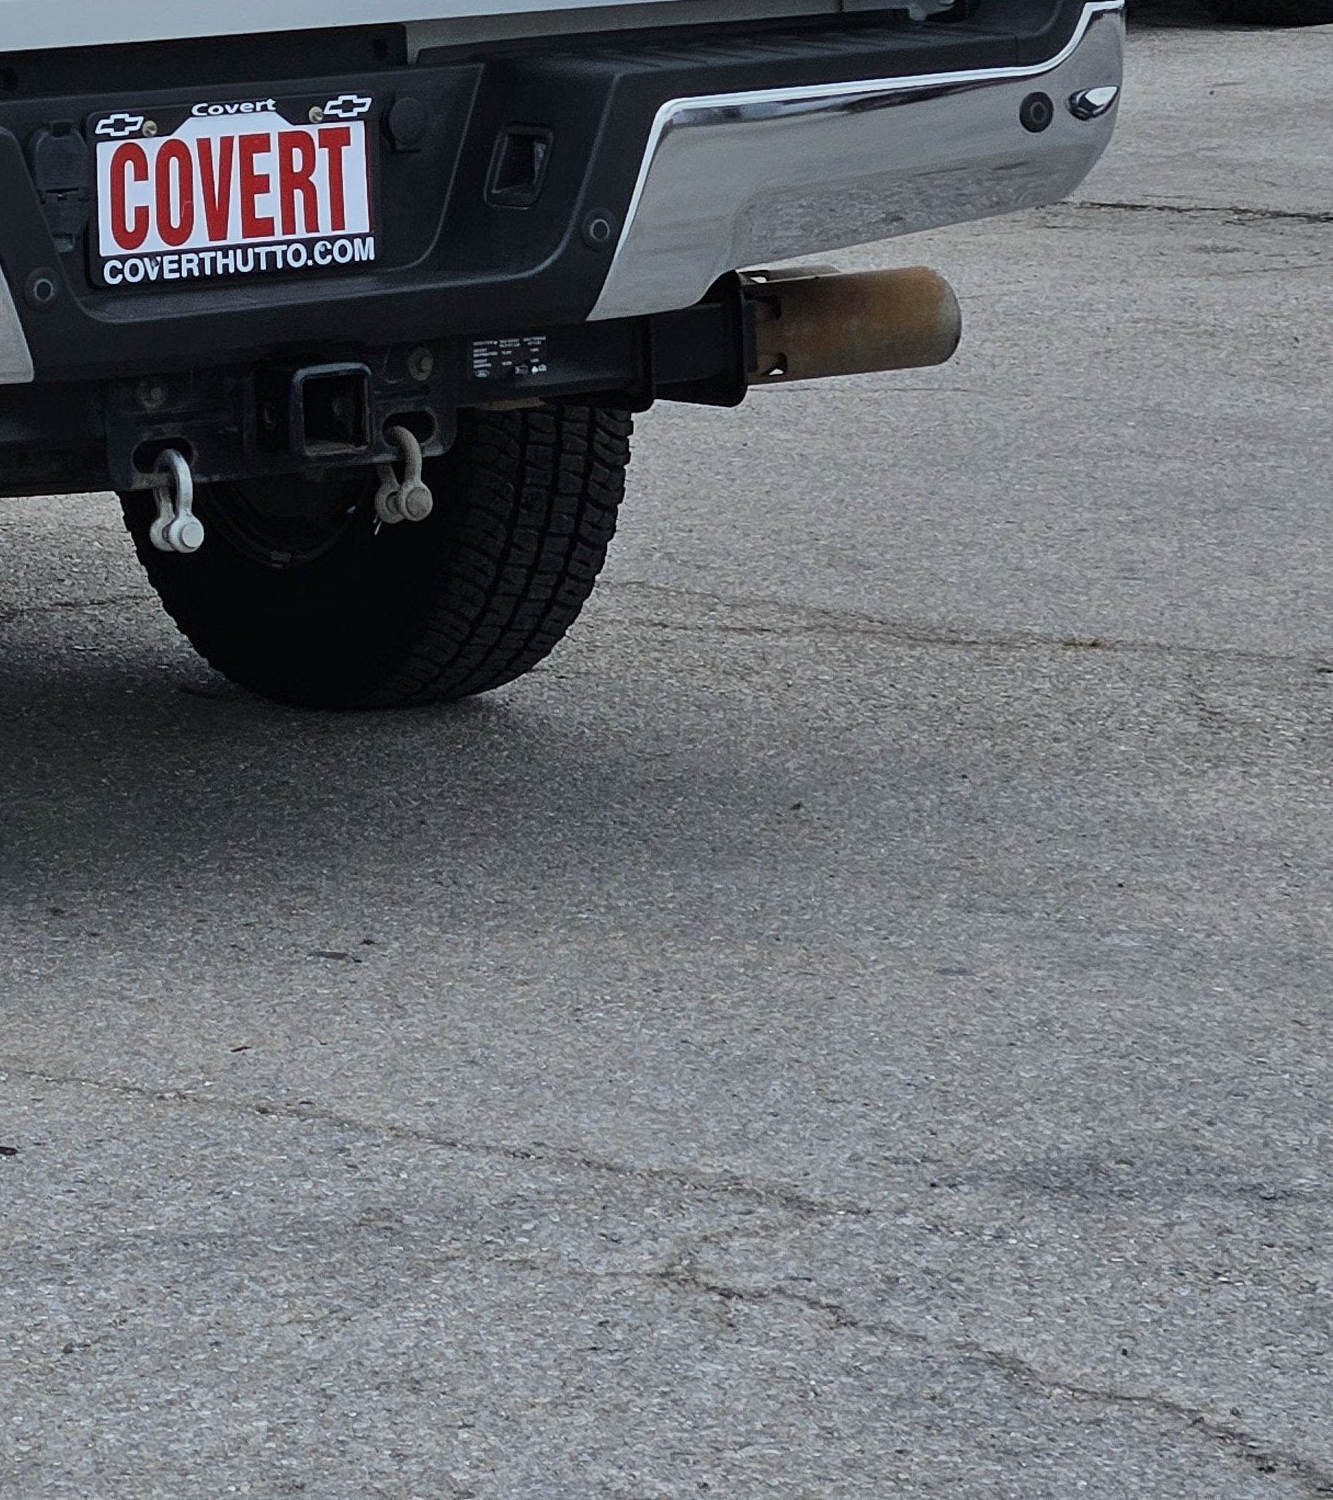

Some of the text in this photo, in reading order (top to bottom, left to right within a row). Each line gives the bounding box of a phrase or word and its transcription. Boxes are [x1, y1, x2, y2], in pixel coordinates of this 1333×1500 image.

[191, 98, 277, 116] Covert
[109, 125, 352, 250] COVERT
[103, 236, 375, 285] COVERTHUTTO.COM
